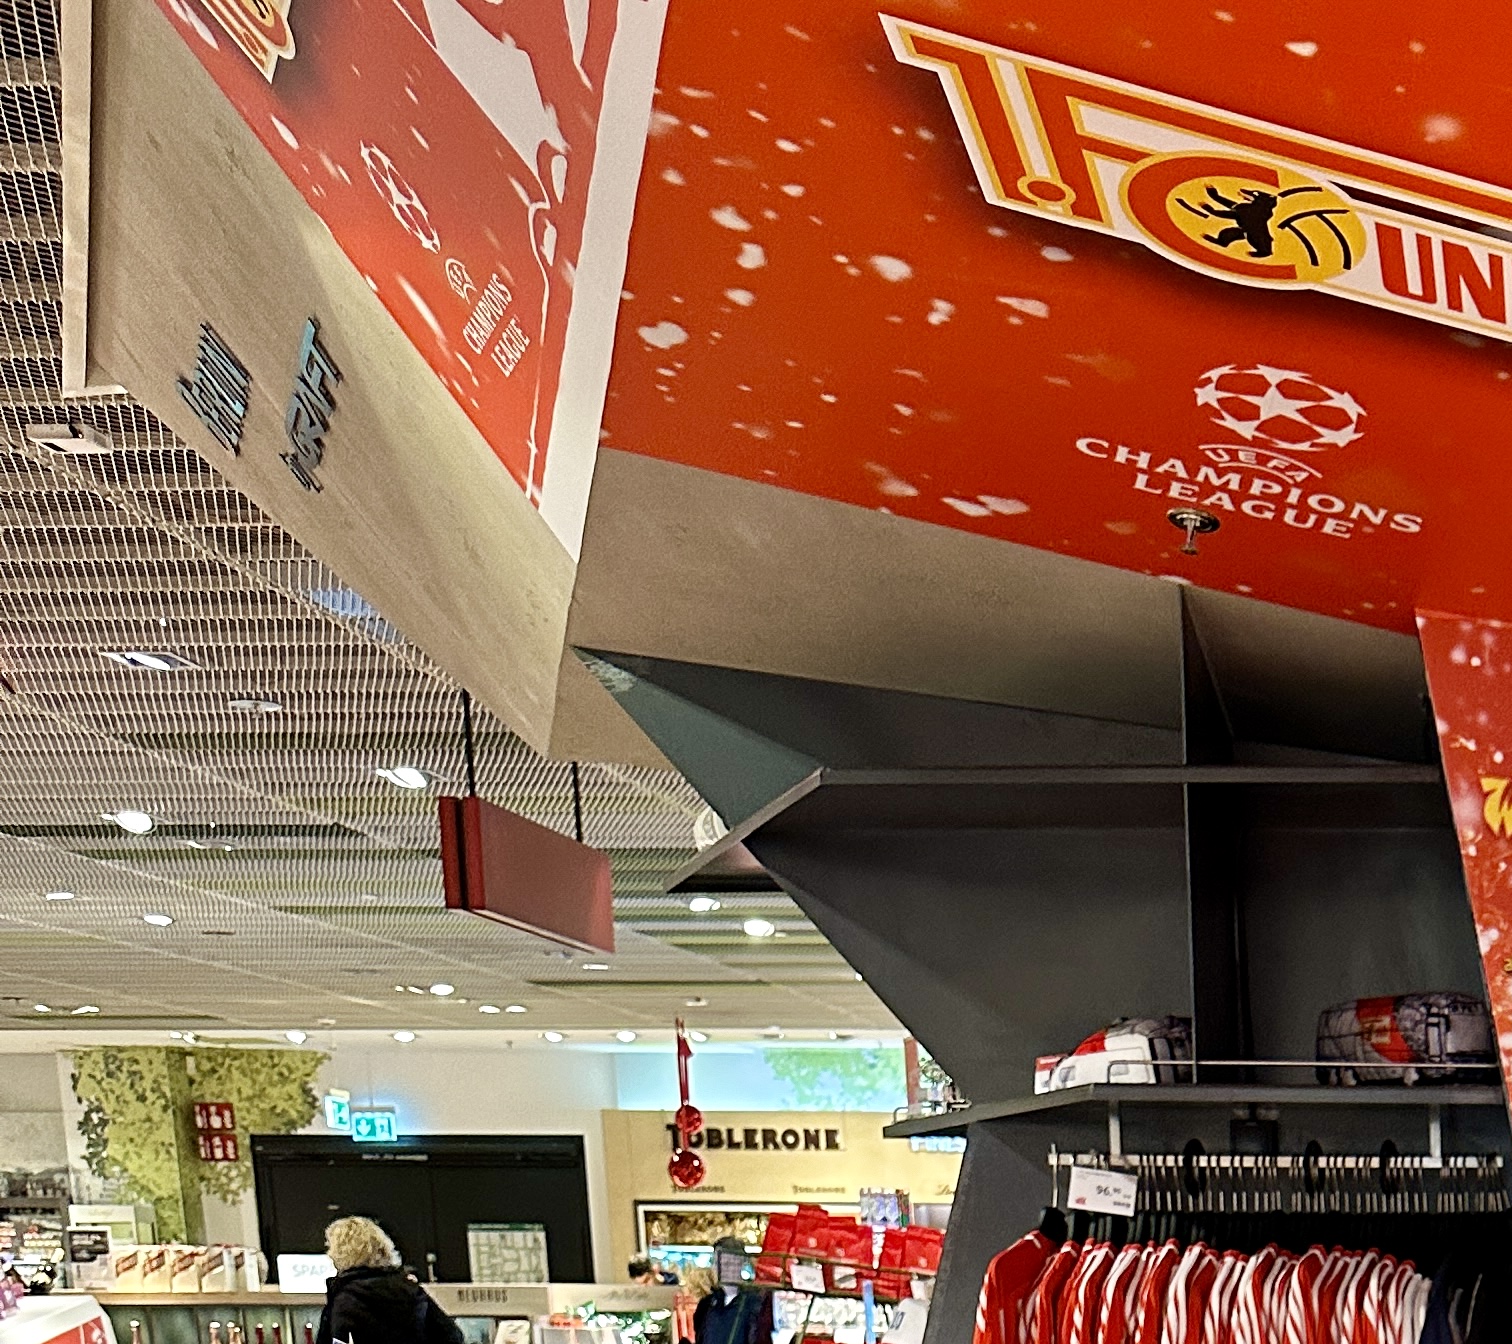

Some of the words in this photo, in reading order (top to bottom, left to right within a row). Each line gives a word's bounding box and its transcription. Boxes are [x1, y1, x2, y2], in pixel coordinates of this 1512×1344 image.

[462, 273, 513, 354] CHAMPIONS
[491, 316, 531, 377] LEAGUE
[1074, 437, 1423, 534] CHAMPIONS
[1203, 446, 1309, 482] UEFA
[1133, 472, 1354, 540] LEAGUE
